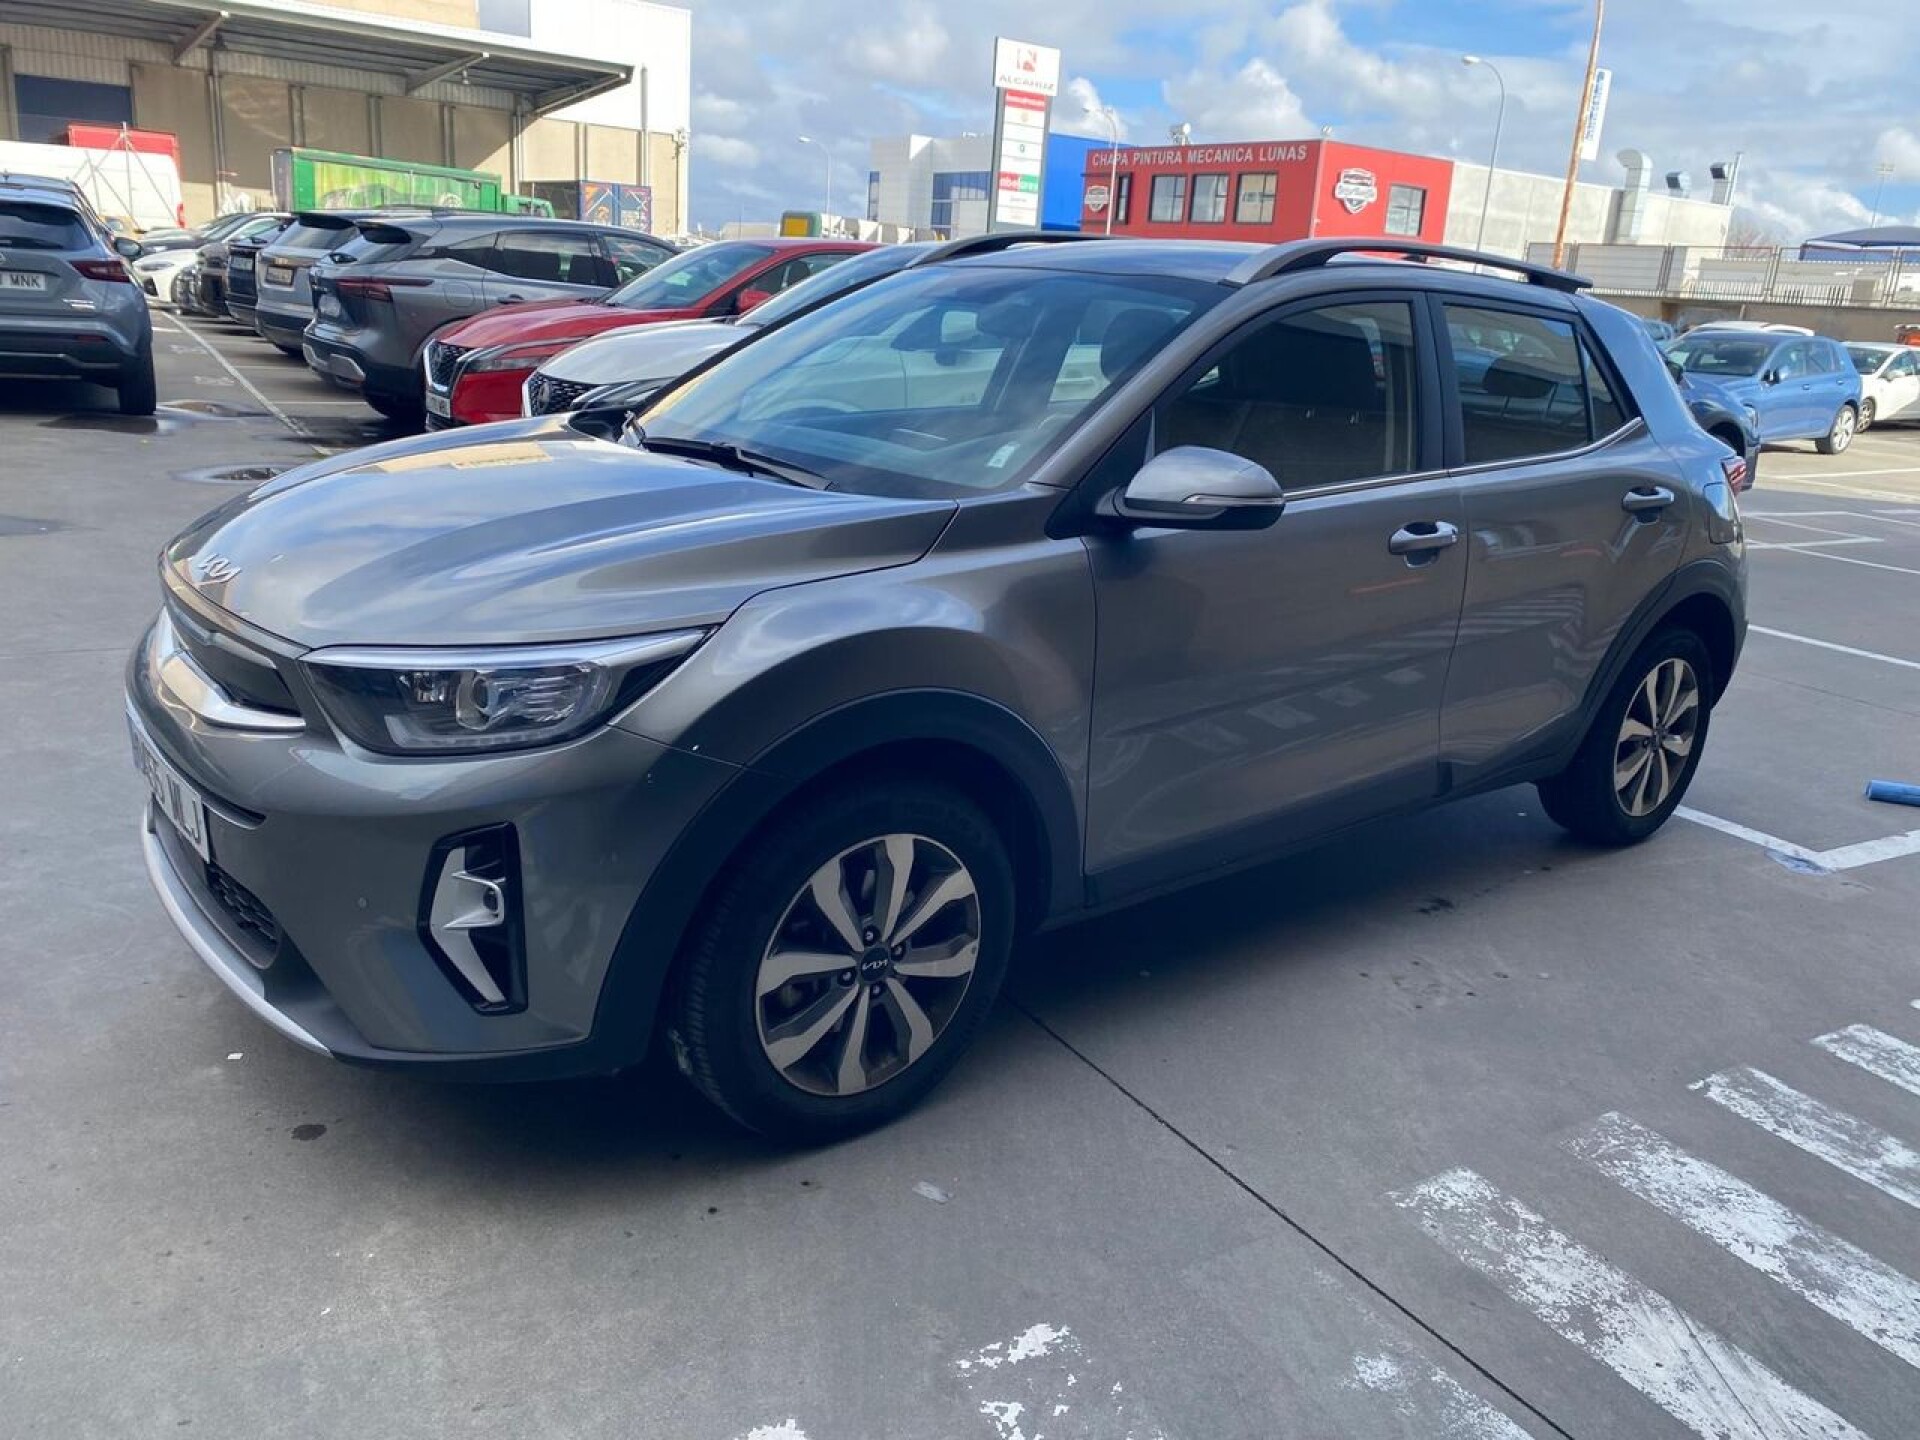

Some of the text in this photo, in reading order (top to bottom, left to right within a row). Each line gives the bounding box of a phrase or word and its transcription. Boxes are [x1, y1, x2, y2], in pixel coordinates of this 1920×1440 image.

[1092, 144, 1308, 166] CHAPA PINTURA MECANICA LUNAS
[10, 274, 41, 288] MNK
